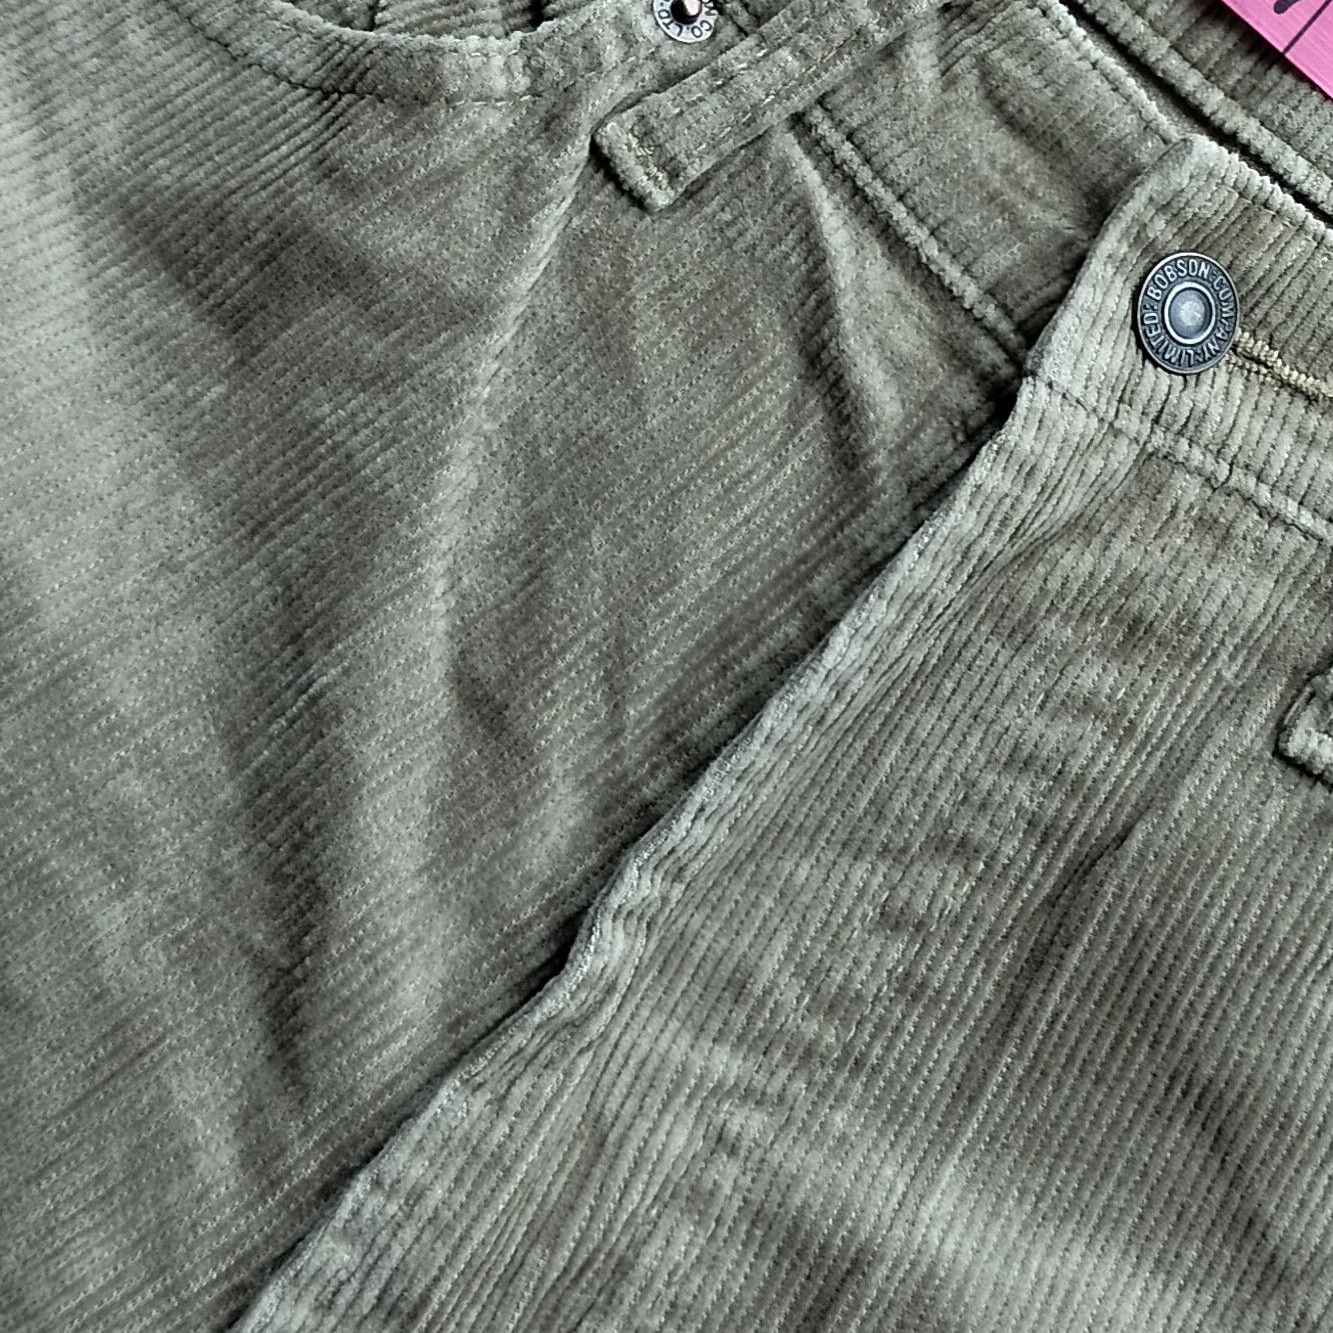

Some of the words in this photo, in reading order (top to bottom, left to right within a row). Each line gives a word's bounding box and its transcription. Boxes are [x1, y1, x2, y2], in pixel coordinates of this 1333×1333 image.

[1147, 259, 1210, 301] BOBSON
[1143, 312, 1196, 366] LIMITED
[1202, 275, 1235, 360] COMPANY
